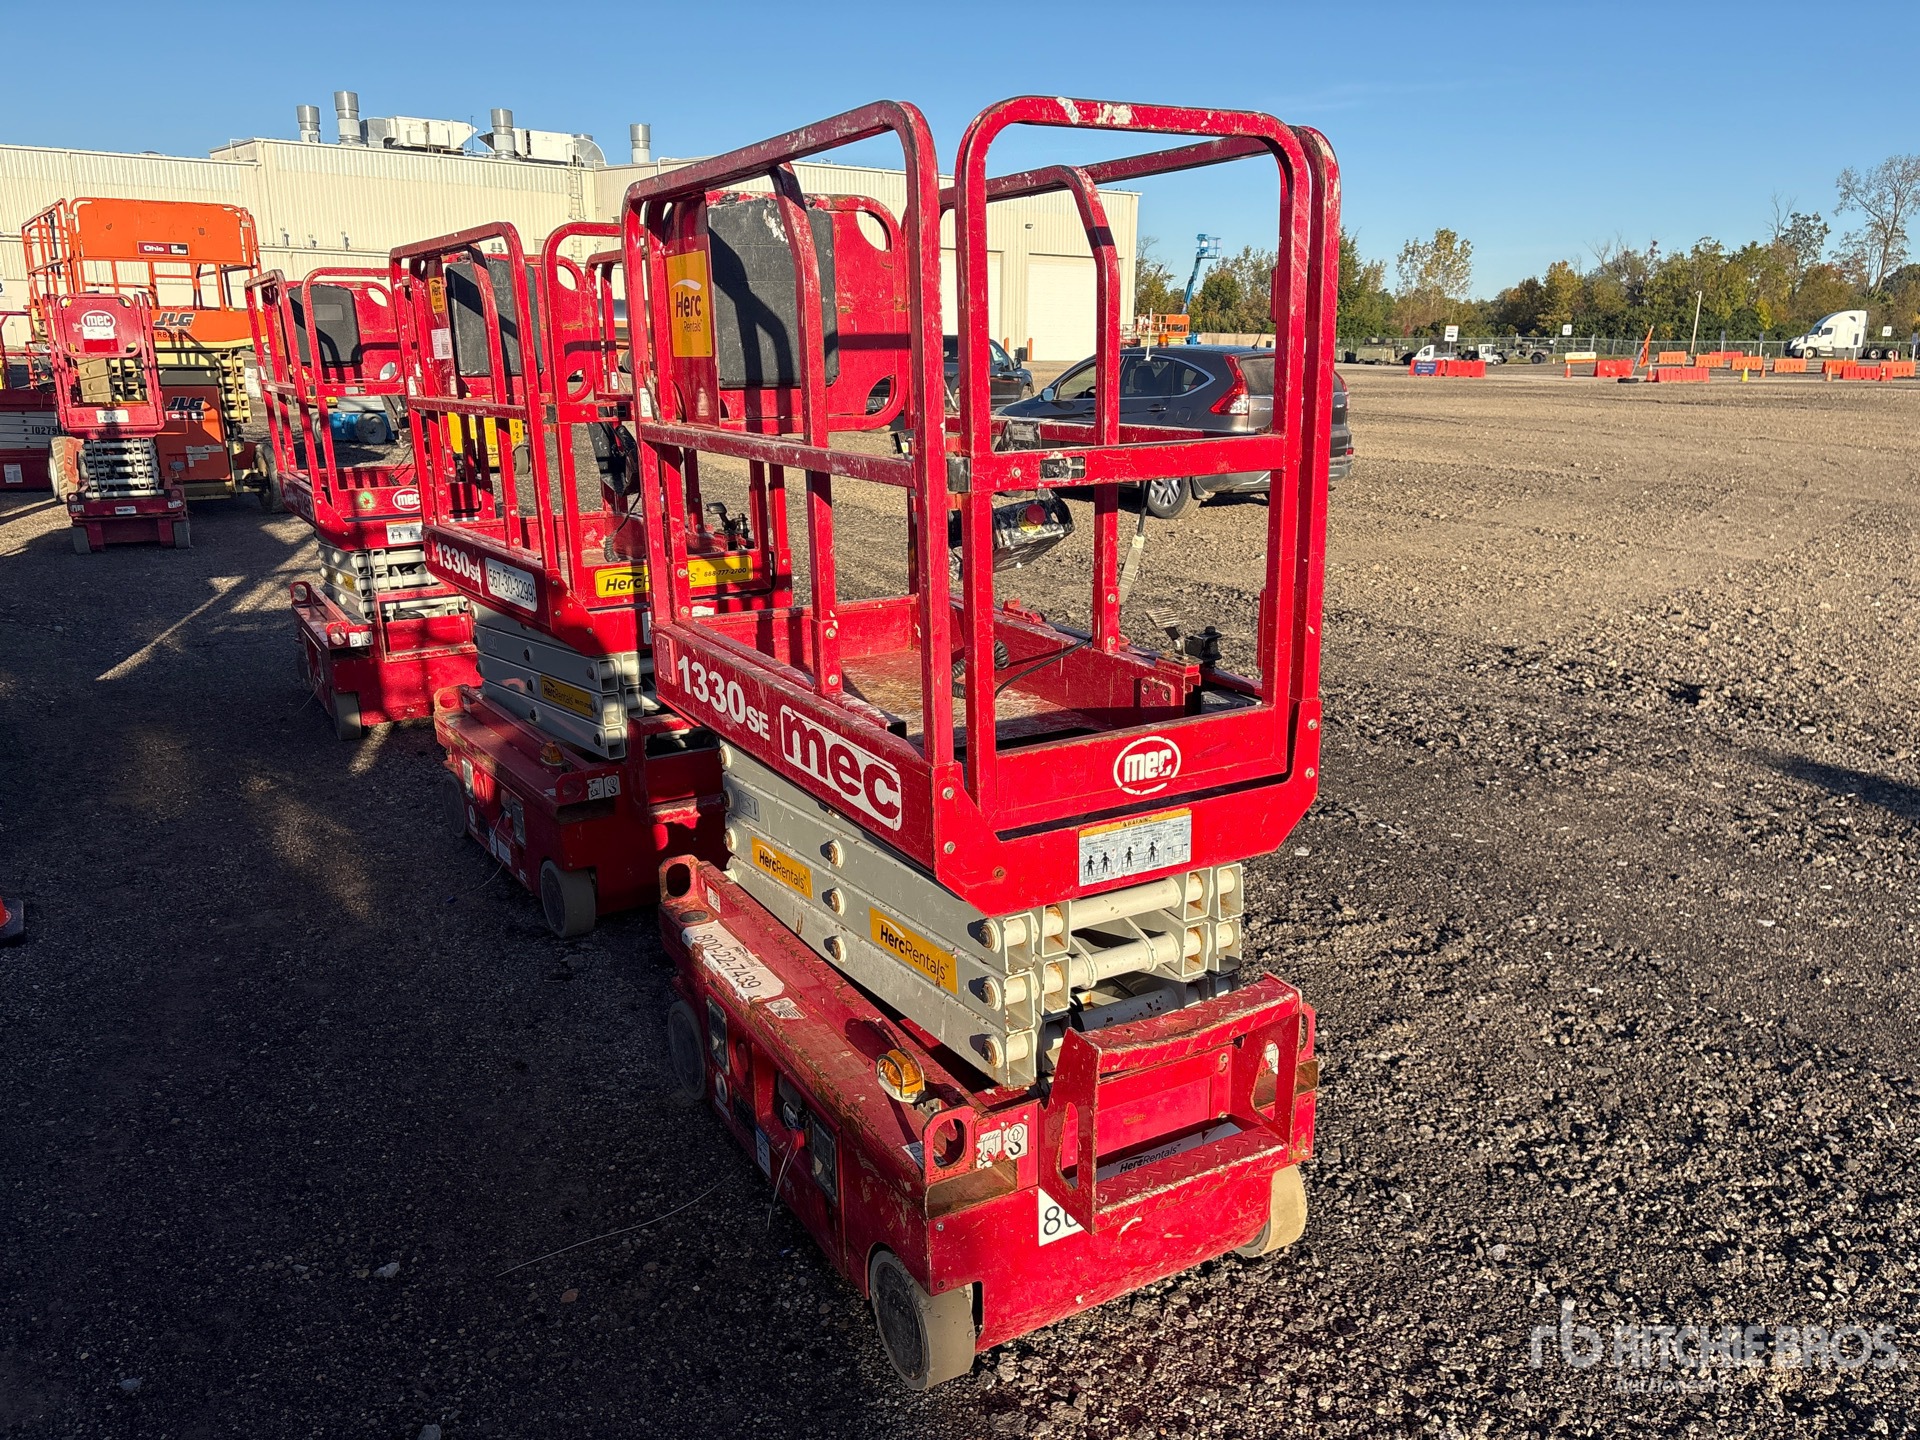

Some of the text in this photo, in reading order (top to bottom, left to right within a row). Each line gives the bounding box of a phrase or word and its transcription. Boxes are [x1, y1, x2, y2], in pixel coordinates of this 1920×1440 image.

[675, 291, 702, 318] Herc
[86, 315, 111, 326] mec
[154, 312, 195, 327] JLG
[683, 320, 703, 333] Rentals
[166, 396, 205, 411] JLG
[398, 492, 420, 507] mec
[678, 656, 901, 822] 1330SE mec
[1124, 749, 1172, 782] mec
[759, 849, 805, 889] HercRentals
[695, 934, 762, 989] 800-22-7439
[880, 924, 946, 980] HercRentals
[1120, 1145, 1178, 1173] HercRentals
